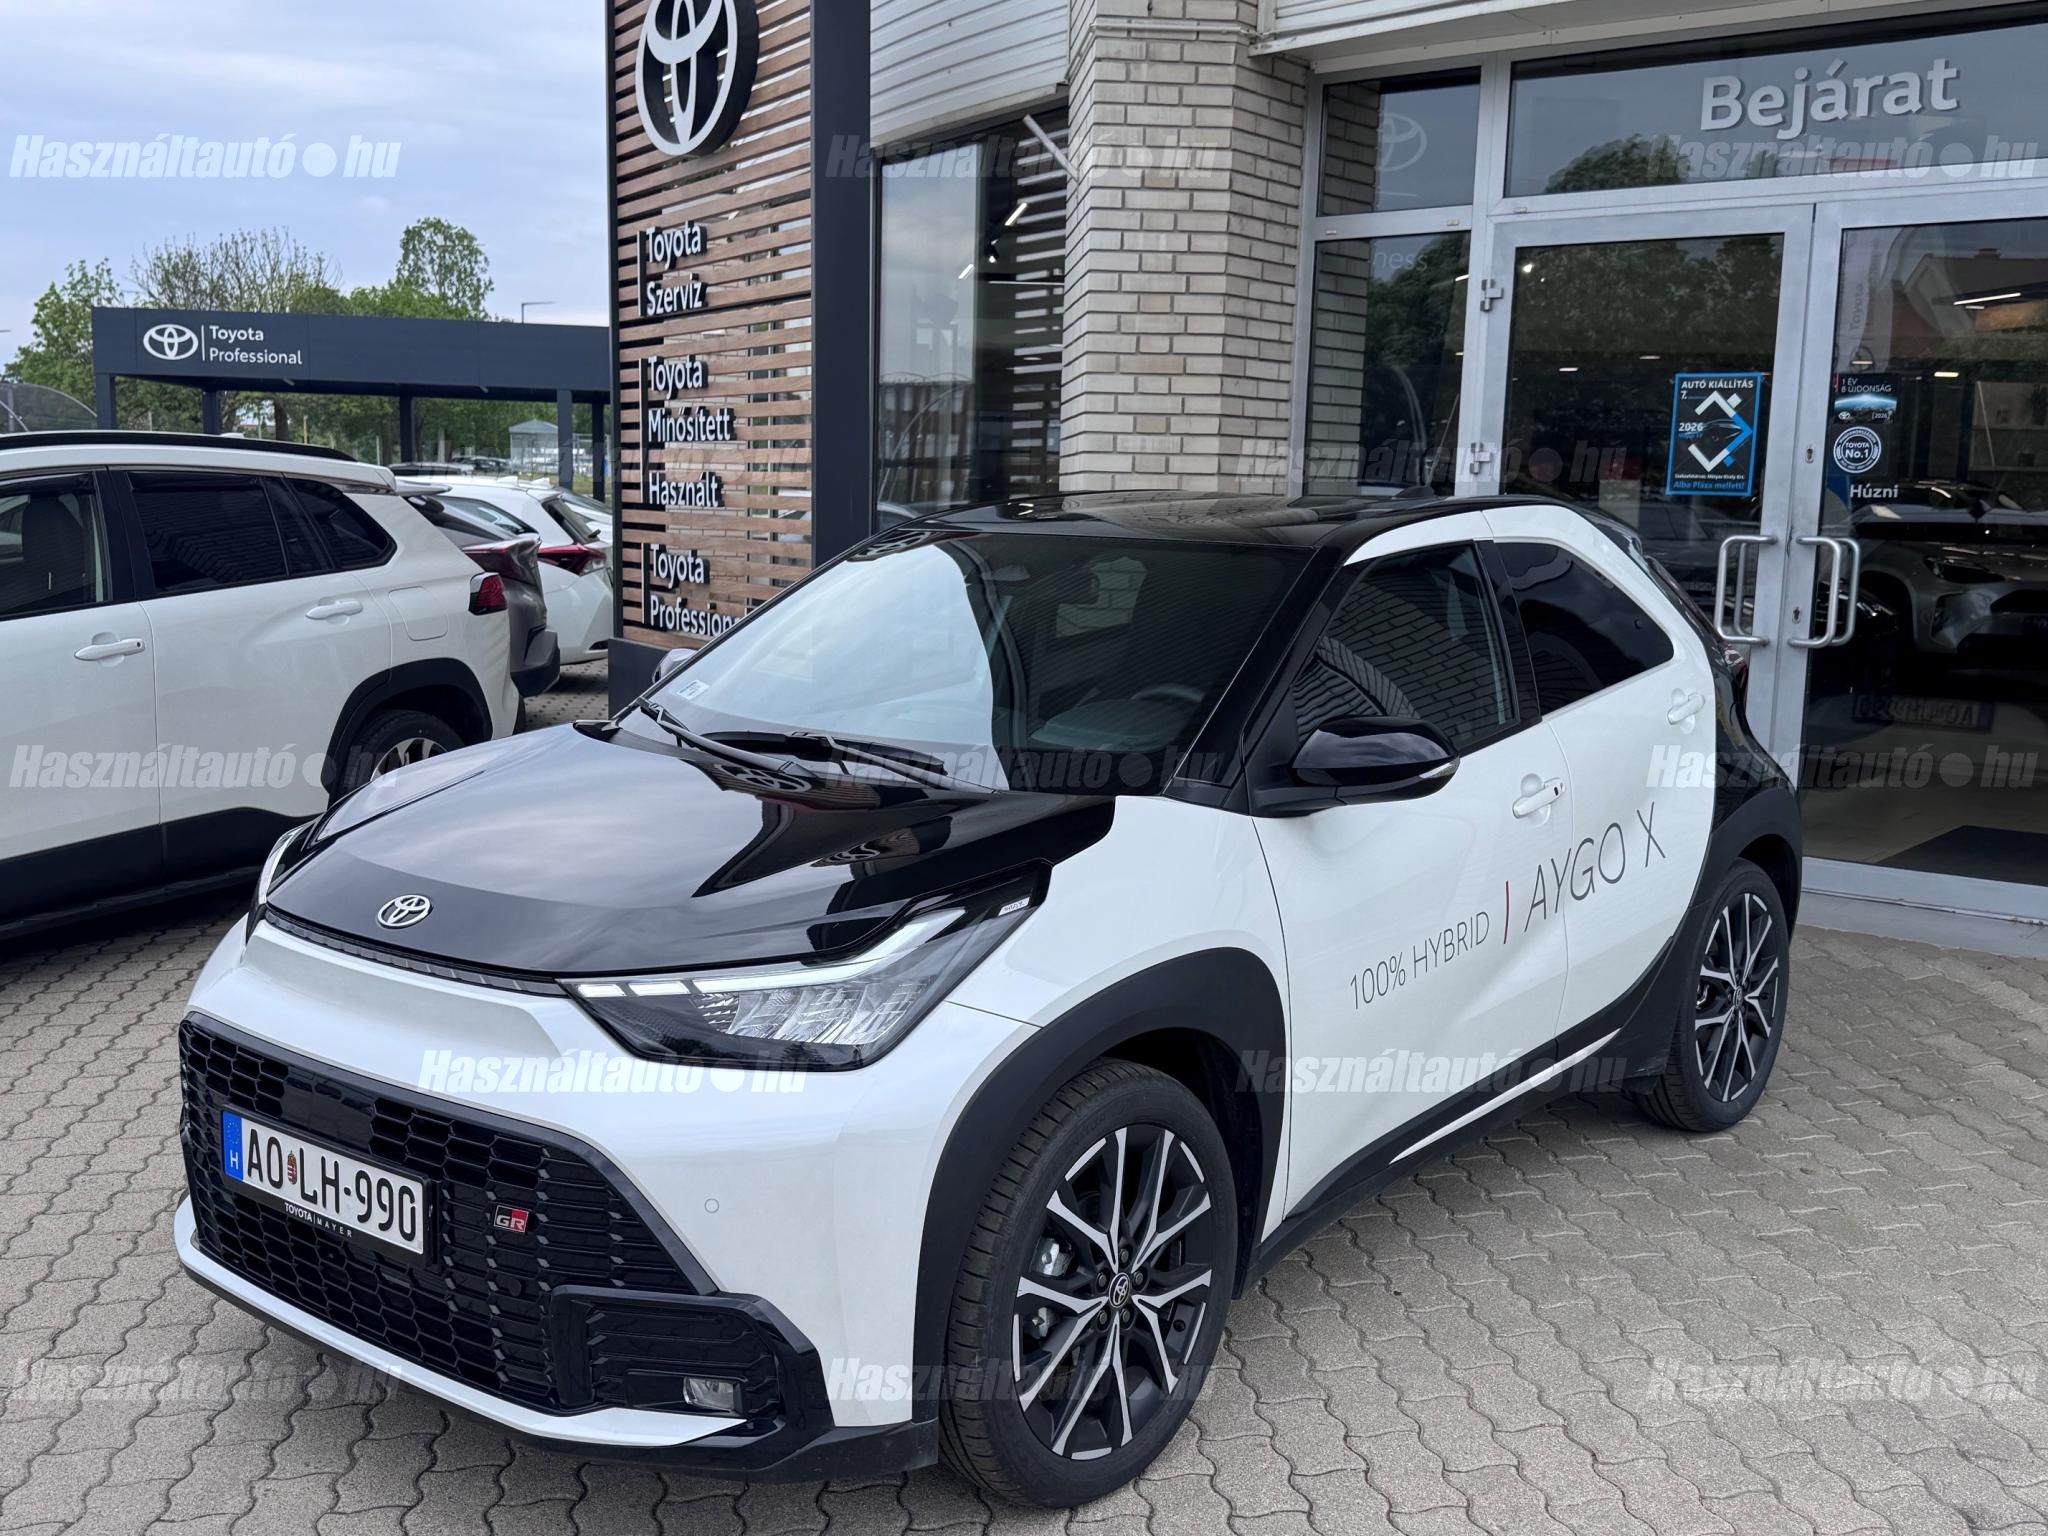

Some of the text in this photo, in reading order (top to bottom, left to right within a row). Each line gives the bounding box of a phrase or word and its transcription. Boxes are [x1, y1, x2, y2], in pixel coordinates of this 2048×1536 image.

[1700, 58, 1959, 140] Bejárat
[646, 224, 703, 269] Toyota
[646, 274, 703, 316] Szerviz
[209, 325, 264, 343] Toyota
[209, 348, 303, 365] Professional
[647, 356, 704, 400] Toyota
[1681, 379, 1754, 389] AUTÓ KIÁLLÍTÁS
[647, 406, 732, 443] Minősített
[1678, 422, 1704, 432] 2026
[1845, 449, 1869, 458] No.1
[648, 470, 720, 508] Használt
[1850, 483, 1899, 498] Húzni
[649, 543, 705, 589] Toyota
[650, 594, 747, 636] Profession
[1350, 801, 1666, 1010] 100% HYBRID AYGO X
[230, 1151, 239, 1171] H
[284, 1202, 352, 1238] TOYOTA MAYER
[496, 1213, 526, 1231] GR
